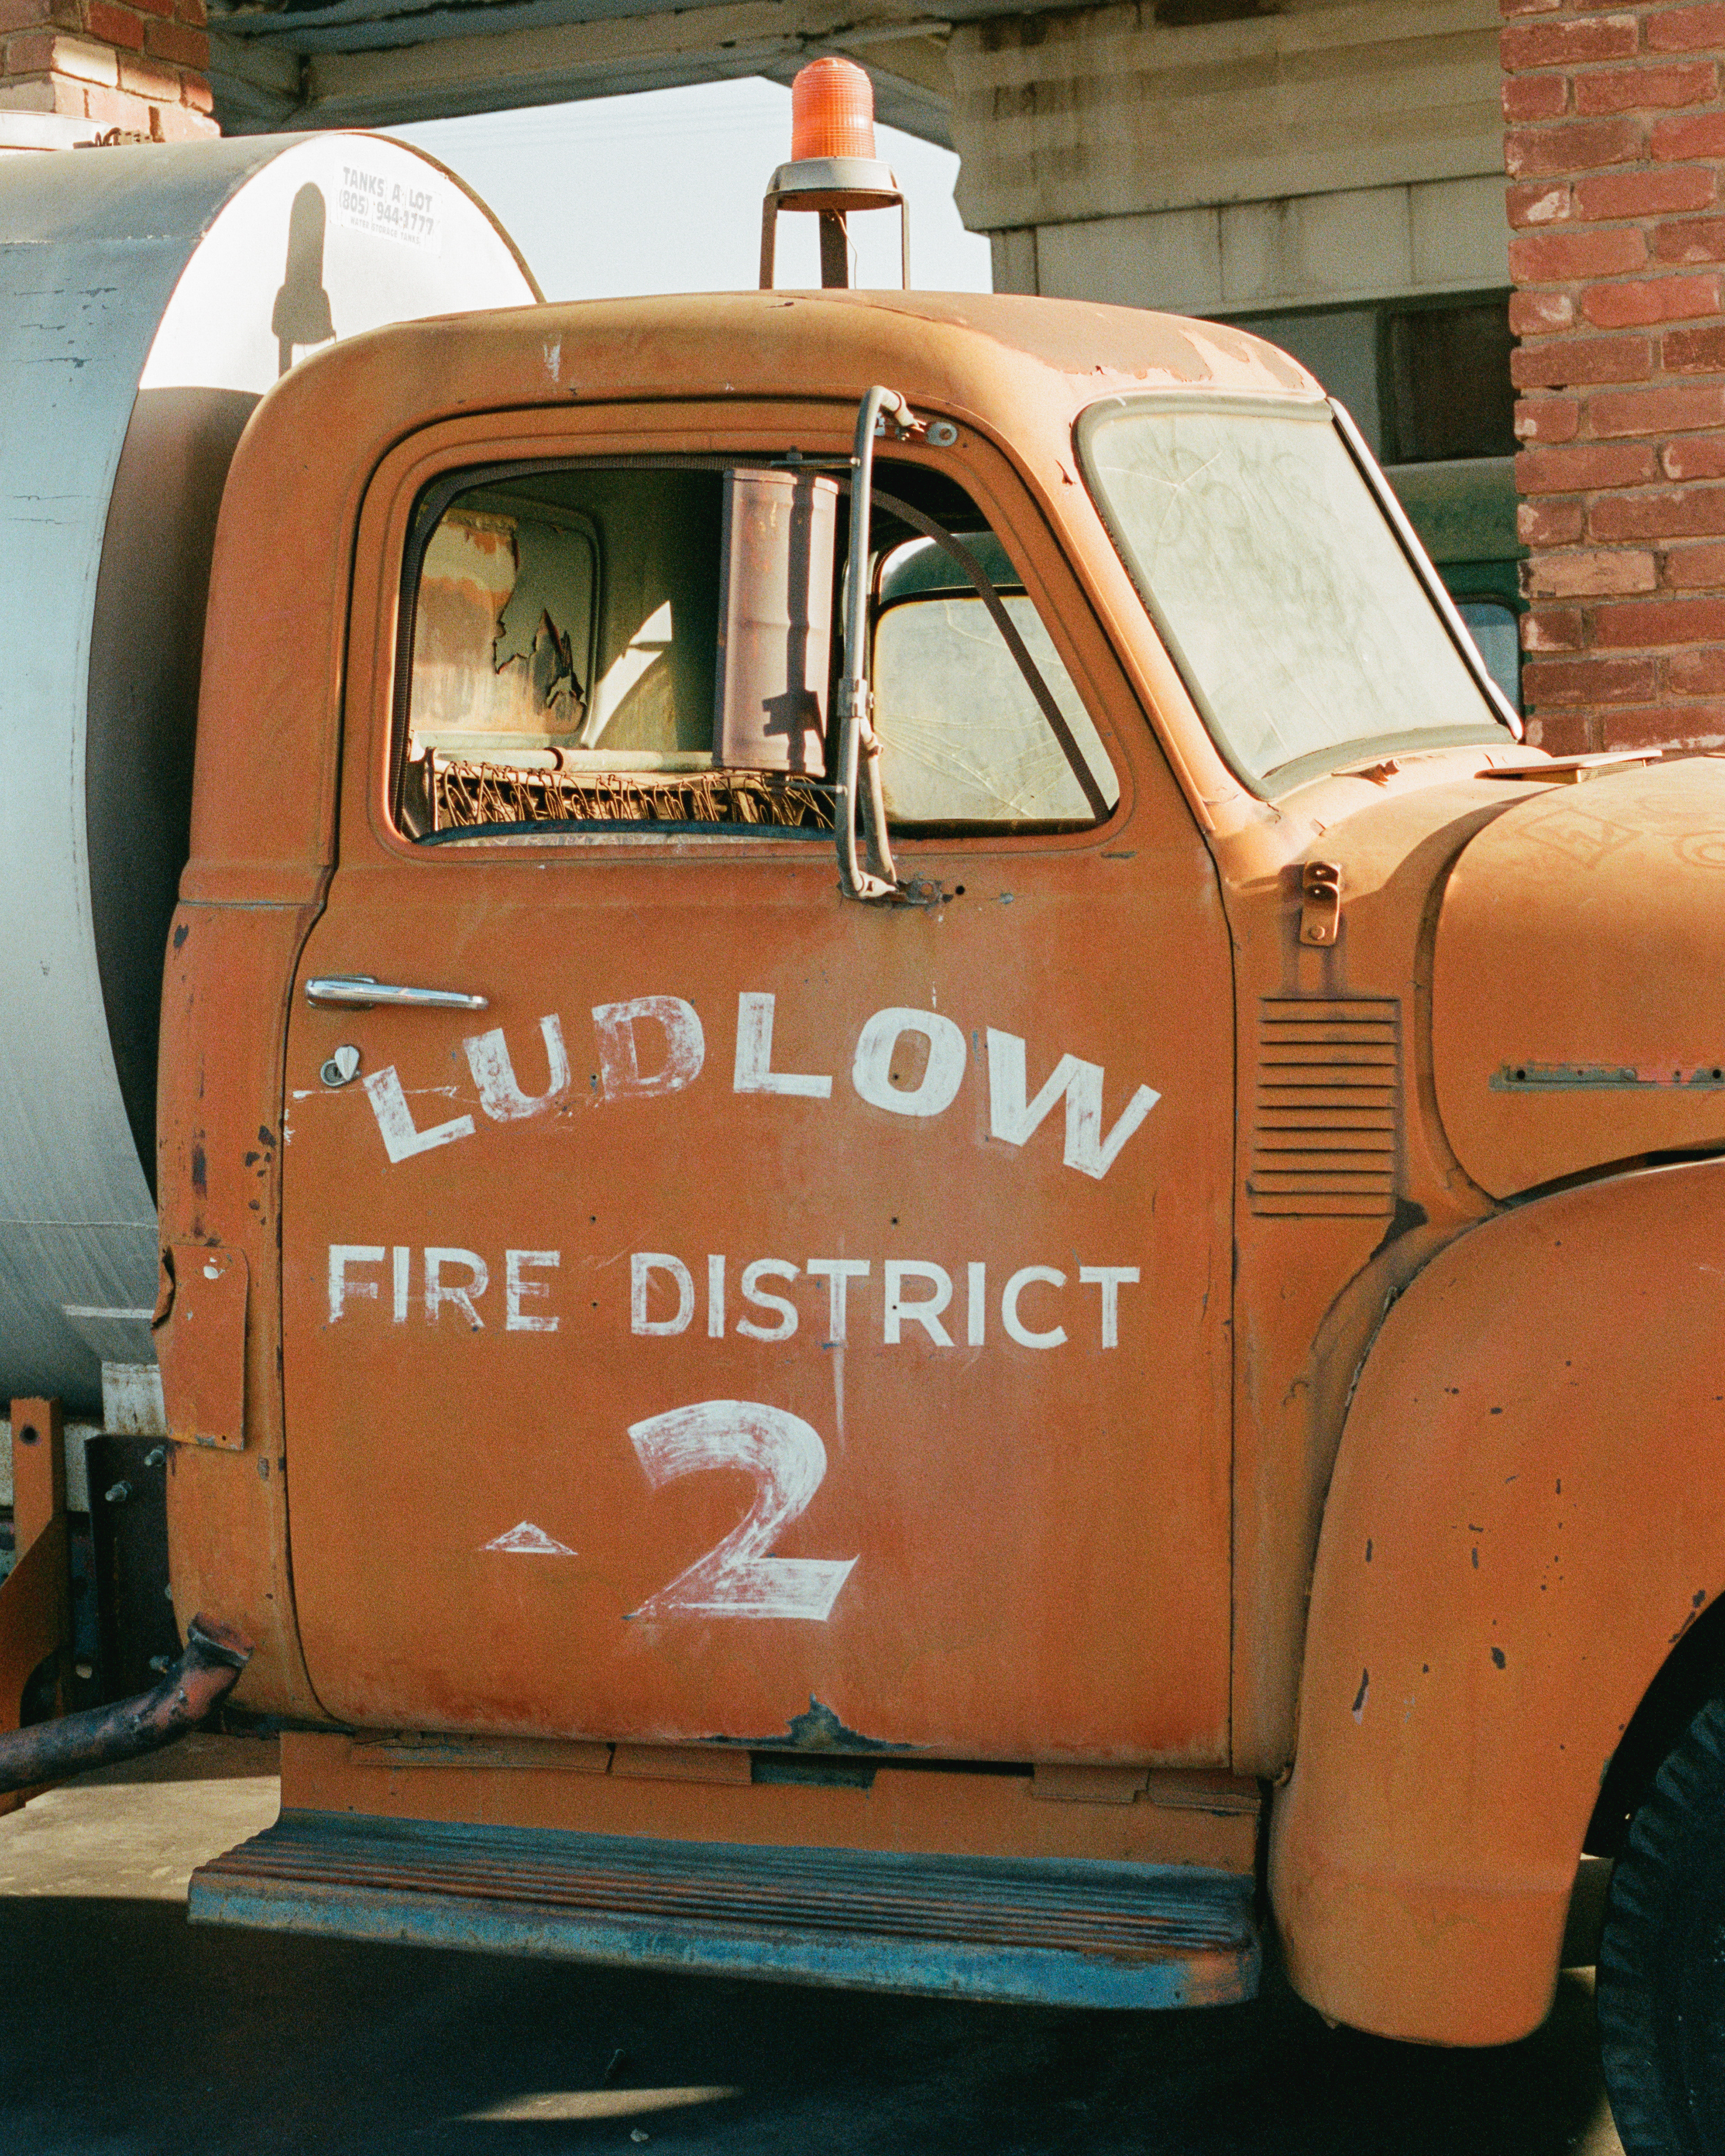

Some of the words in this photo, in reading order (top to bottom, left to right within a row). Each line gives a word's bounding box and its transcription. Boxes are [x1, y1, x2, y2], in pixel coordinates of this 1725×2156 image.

[339, 189, 369, 216] (805)
[376, 202, 434, 235] 944-1777
[343, 166, 385, 197] TANKS
[392, 183, 401, 203] A
[409, 189, 433, 212] LOT
[350, 216, 369, 229] WATER
[401, 232, 421, 244] TANKS
[361, 991, 1162, 1181] LUDLOW
[327, 1244, 562, 1333] FIRE
[630, 1251, 1141, 1352] DISTRICT
[627, 1399, 860, 1622] 2
